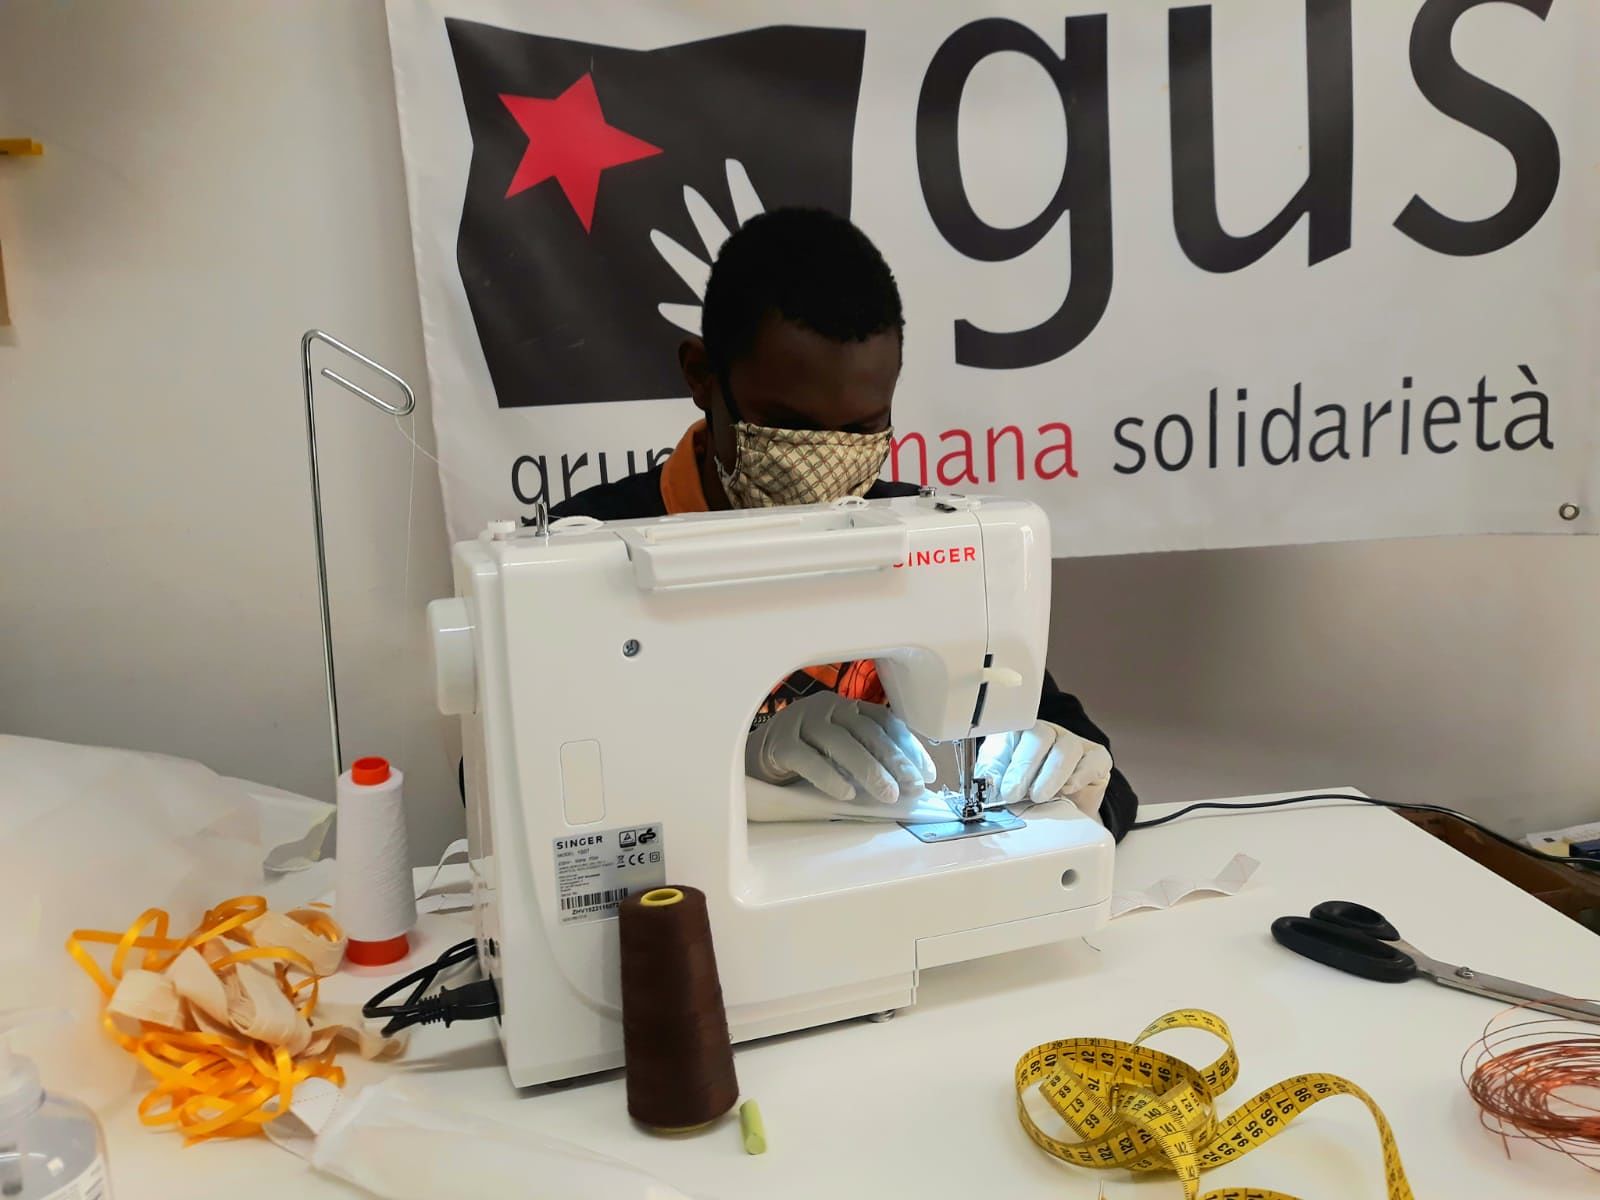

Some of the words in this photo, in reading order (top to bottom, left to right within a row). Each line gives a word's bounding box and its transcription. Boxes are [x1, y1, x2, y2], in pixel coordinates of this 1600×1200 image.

[916, 0, 1560, 369] gus
[511, 447, 676, 527] gru
[1113, 365, 1554, 475] solidarietà
[556, 835, 603, 850] SINGER
[1030, 1060, 1041, 1076] 39
[1044, 1053, 1057, 1067] 40
[1081, 1050, 1095, 1064] 42
[1101, 1052, 1114, 1067] 43
[1139, 1061, 1152, 1078] 45
[1071, 1098, 1085, 1113] 67
[1085, 1114, 1100, 1129] 66
[1143, 1107, 1162, 1120] 140
[1159, 1121, 1178, 1136] 141
[1217, 1142, 1236, 1156] 93
[1231, 1131, 1250, 1148] 94
[1245, 1120, 1264, 1138] 95
[1260, 1108, 1279, 1127] 96
[1275, 1097, 1294, 1115] 97
[1294, 1087, 1313, 1103] 98
[1118, 1136, 1134, 1155] 123
